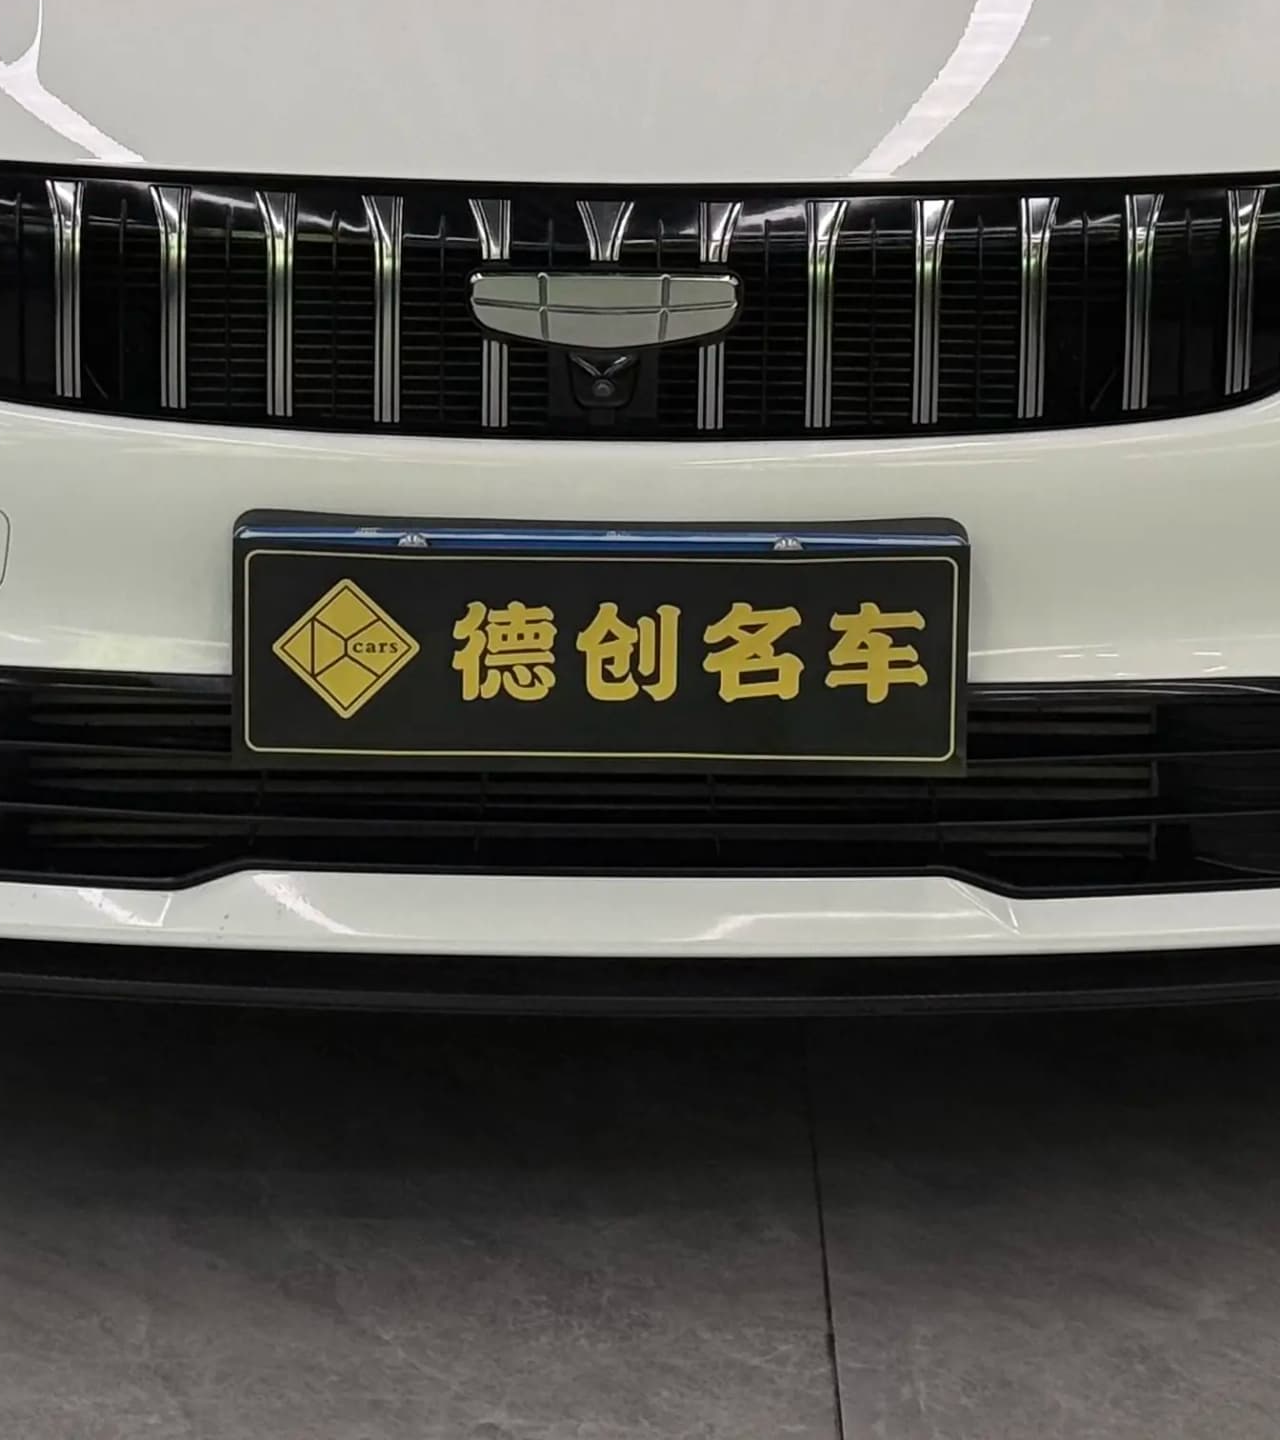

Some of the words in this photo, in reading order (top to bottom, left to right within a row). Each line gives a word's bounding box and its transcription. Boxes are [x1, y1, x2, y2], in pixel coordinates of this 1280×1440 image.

[352, 641, 399, 654] cars
[451, 600, 929, 704] 德创名车
